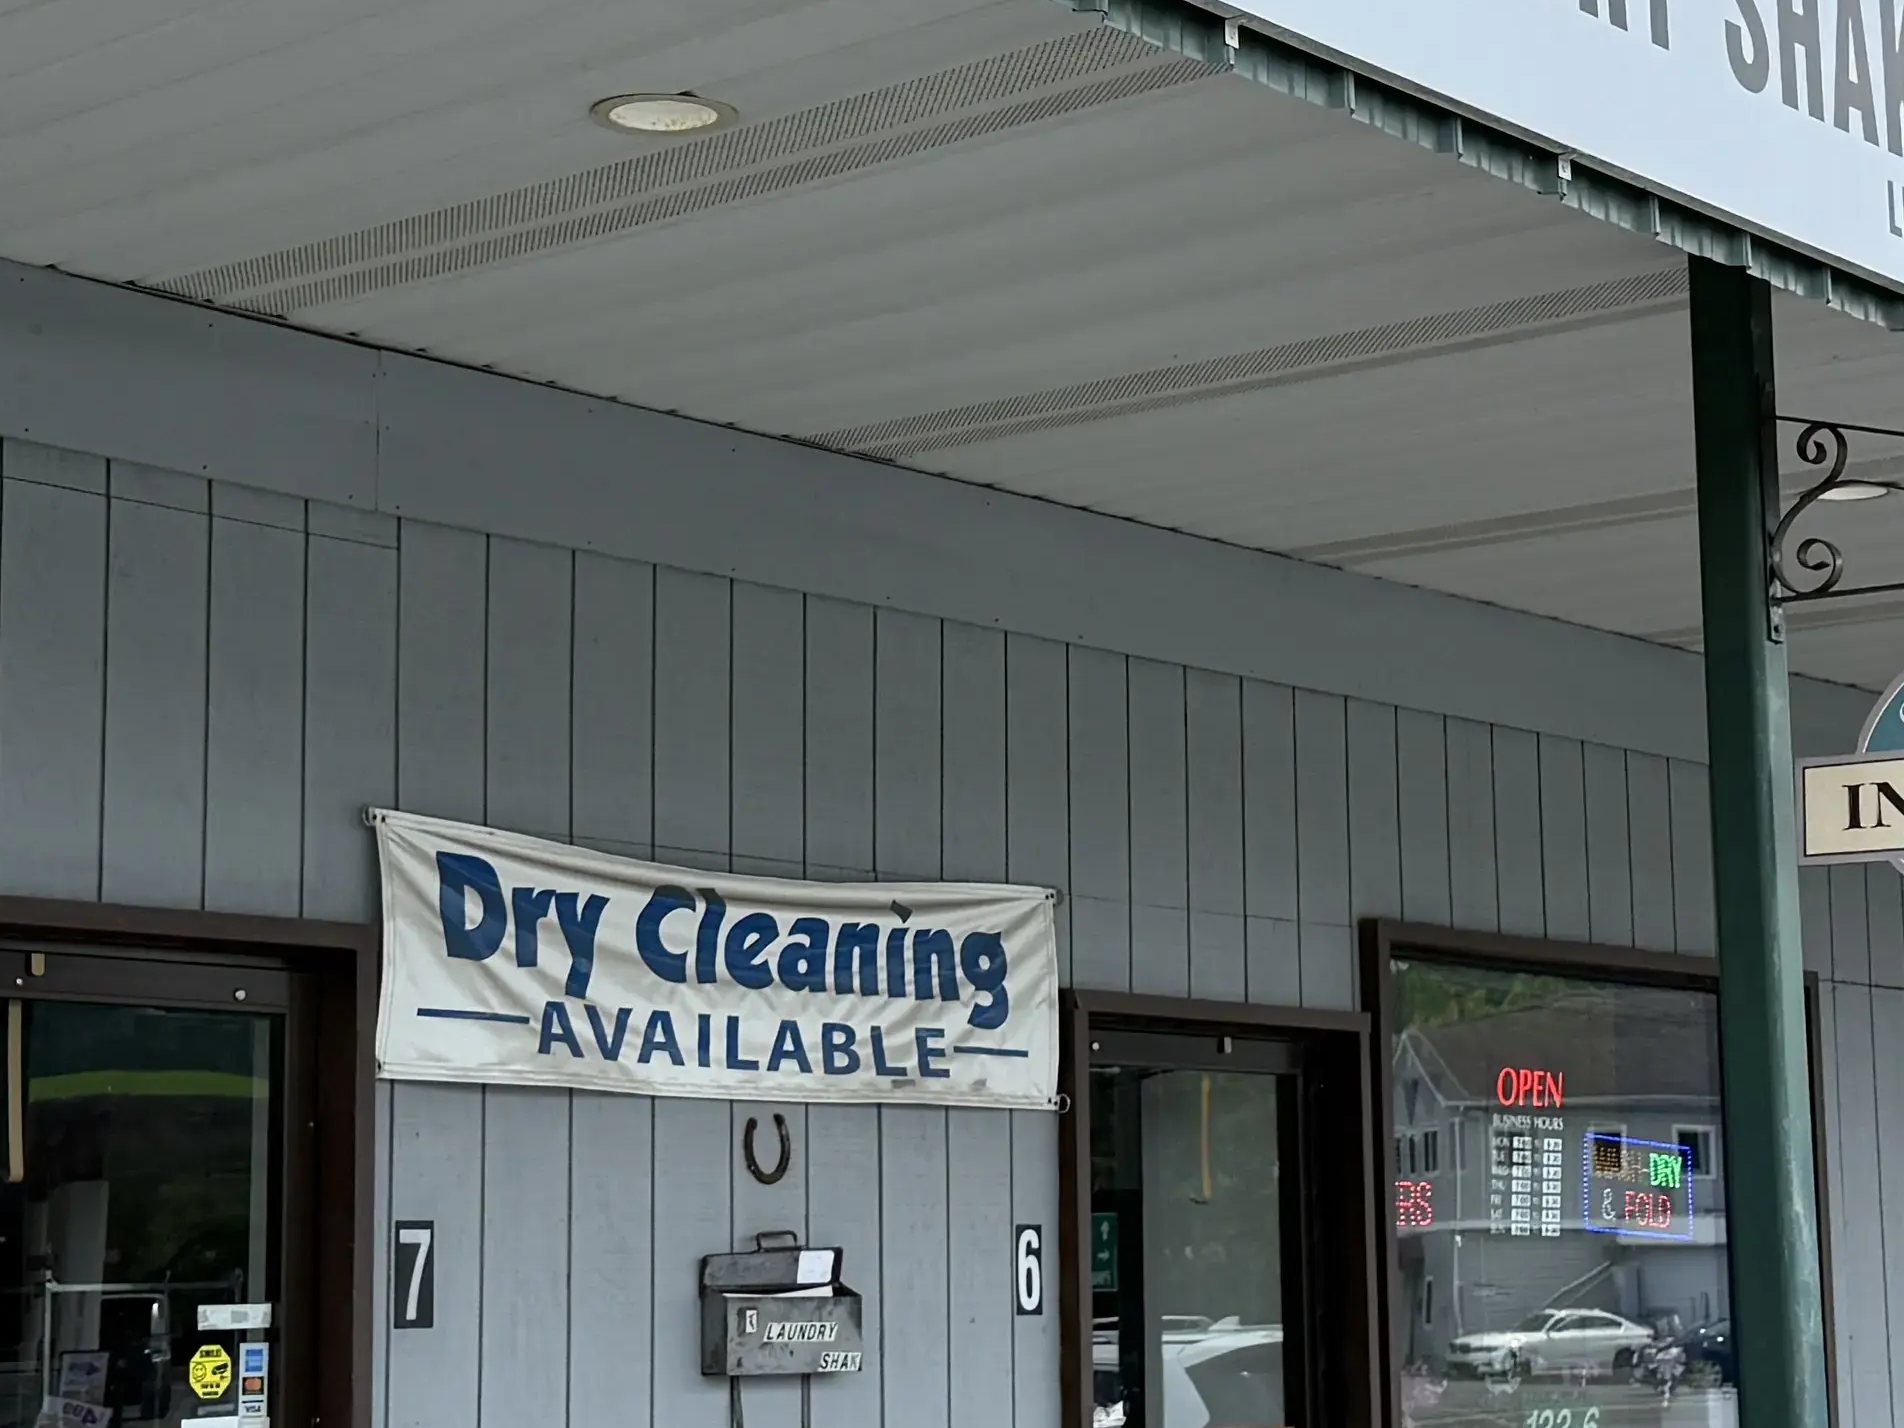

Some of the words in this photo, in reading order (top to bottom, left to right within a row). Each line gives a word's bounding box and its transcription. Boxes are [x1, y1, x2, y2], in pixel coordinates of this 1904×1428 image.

[436, 850, 610, 999] Dry
[635, 884, 1008, 1030] Cleaning
[537, 1000, 950, 1078] AVAILABLE
[1496, 1066, 1564, 1108] OPEN
[1624, 1191, 1672, 1228] FOLD
[399, 1229, 432, 1320] 7
[1017, 1229, 1041, 1311] 6
[766, 1323, 837, 1341] LAUNDRY
[821, 1353, 860, 1371] SHAK
